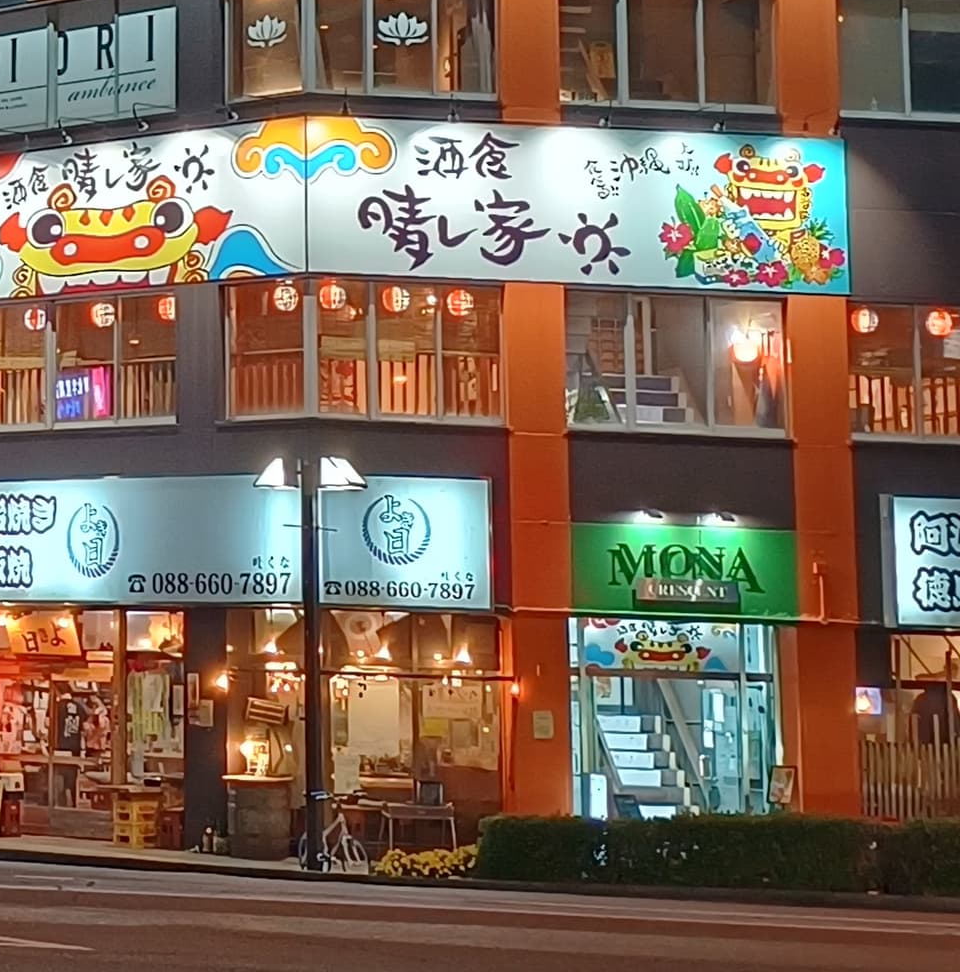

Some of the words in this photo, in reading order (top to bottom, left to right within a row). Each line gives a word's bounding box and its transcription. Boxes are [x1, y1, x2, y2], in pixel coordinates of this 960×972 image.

[67, 75, 157, 103] ambiance
[607, 542, 767, 594] MONA
[152, 572, 292, 596] 088-660-7897
[344, 580, 476, 600] 088-660-7897
